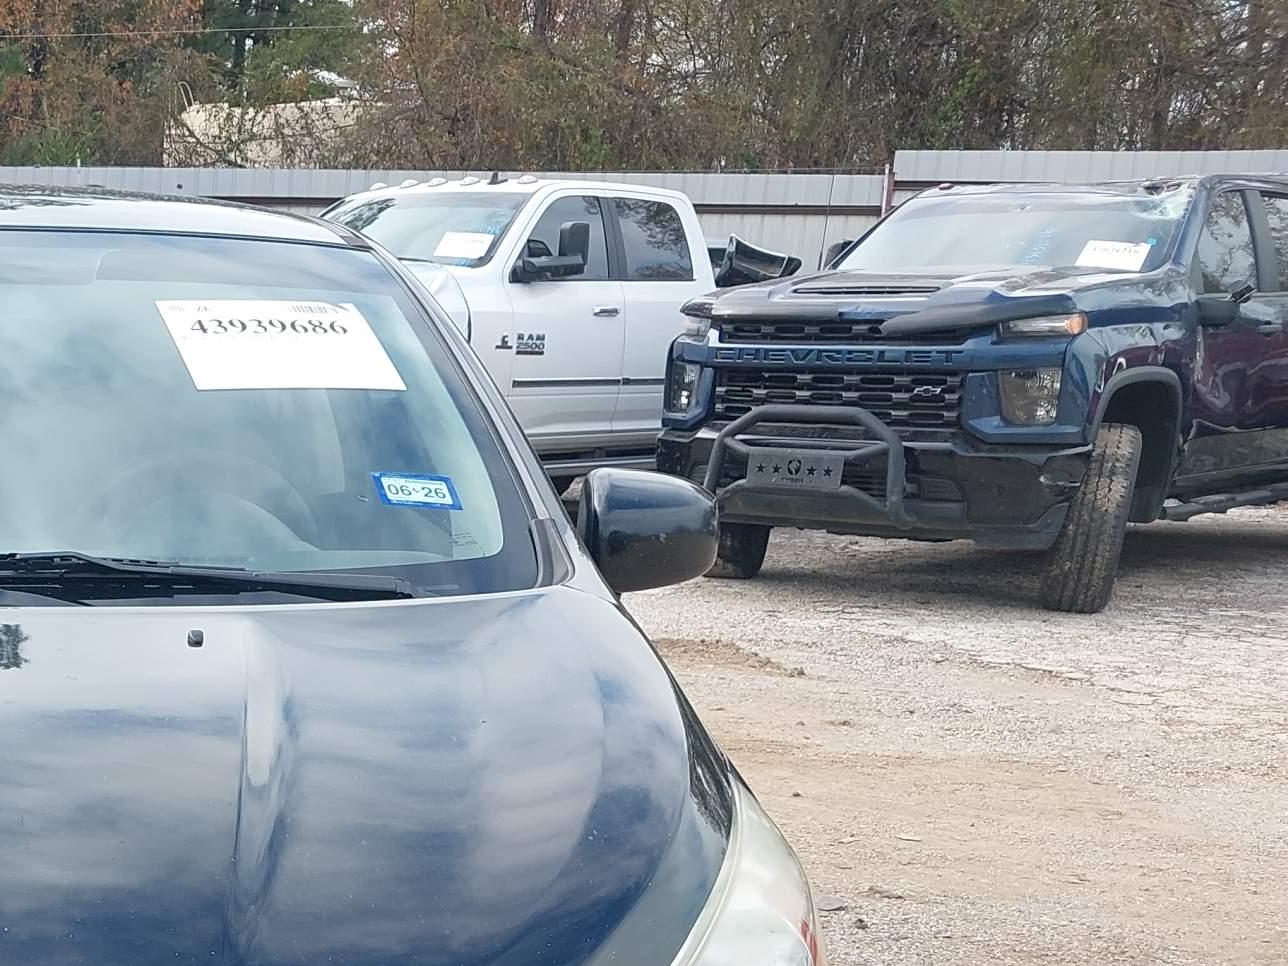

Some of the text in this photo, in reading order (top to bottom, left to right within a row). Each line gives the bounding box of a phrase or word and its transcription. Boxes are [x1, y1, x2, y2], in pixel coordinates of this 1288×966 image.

[190, 318, 348, 335] 43939686
[517, 333, 546, 341] RAM
[516, 342, 545, 350] 2500
[713, 349, 964, 365] CHEVROLET
[387, 483, 412, 496] 06
[421, 486, 446, 499] 26
